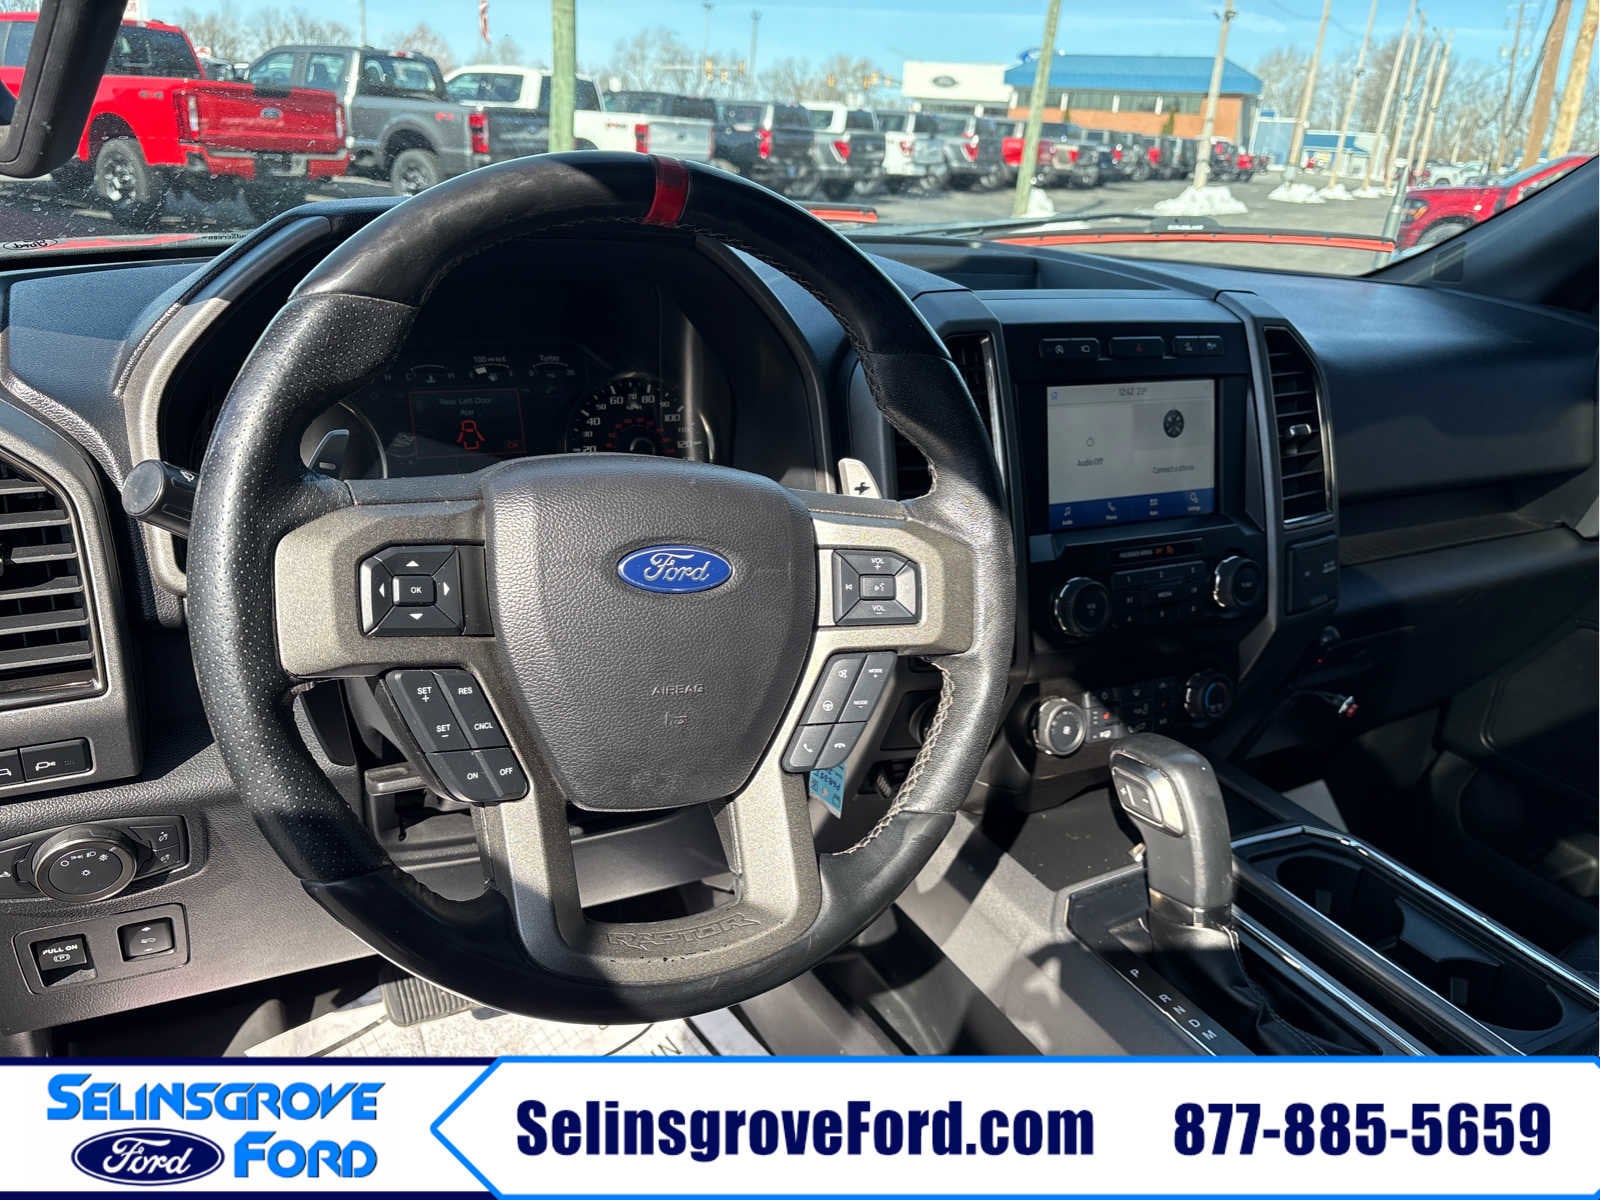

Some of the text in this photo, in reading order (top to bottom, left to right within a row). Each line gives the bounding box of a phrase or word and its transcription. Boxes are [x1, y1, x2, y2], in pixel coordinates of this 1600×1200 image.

[610, 396, 624, 406] 60
[641, 395, 656, 404] 80
[586, 416, 601, 426] 40
[664, 414, 680, 423] 100
[643, 552, 711, 582] Ford
[410, 586, 422, 594] OK
[417, 686, 432, 695] SET
[458, 686, 473, 695] RES
[651, 684, 704, 696] AIRBAG
[436, 724, 451, 732] SET
[473, 721, 494, 731] CNCL
[499, 767, 513, 776] OFF
[466, 772, 479, 781] ON
[607, 911, 761, 951] RAPTOR
[42, 943, 78, 956] PULL ON
